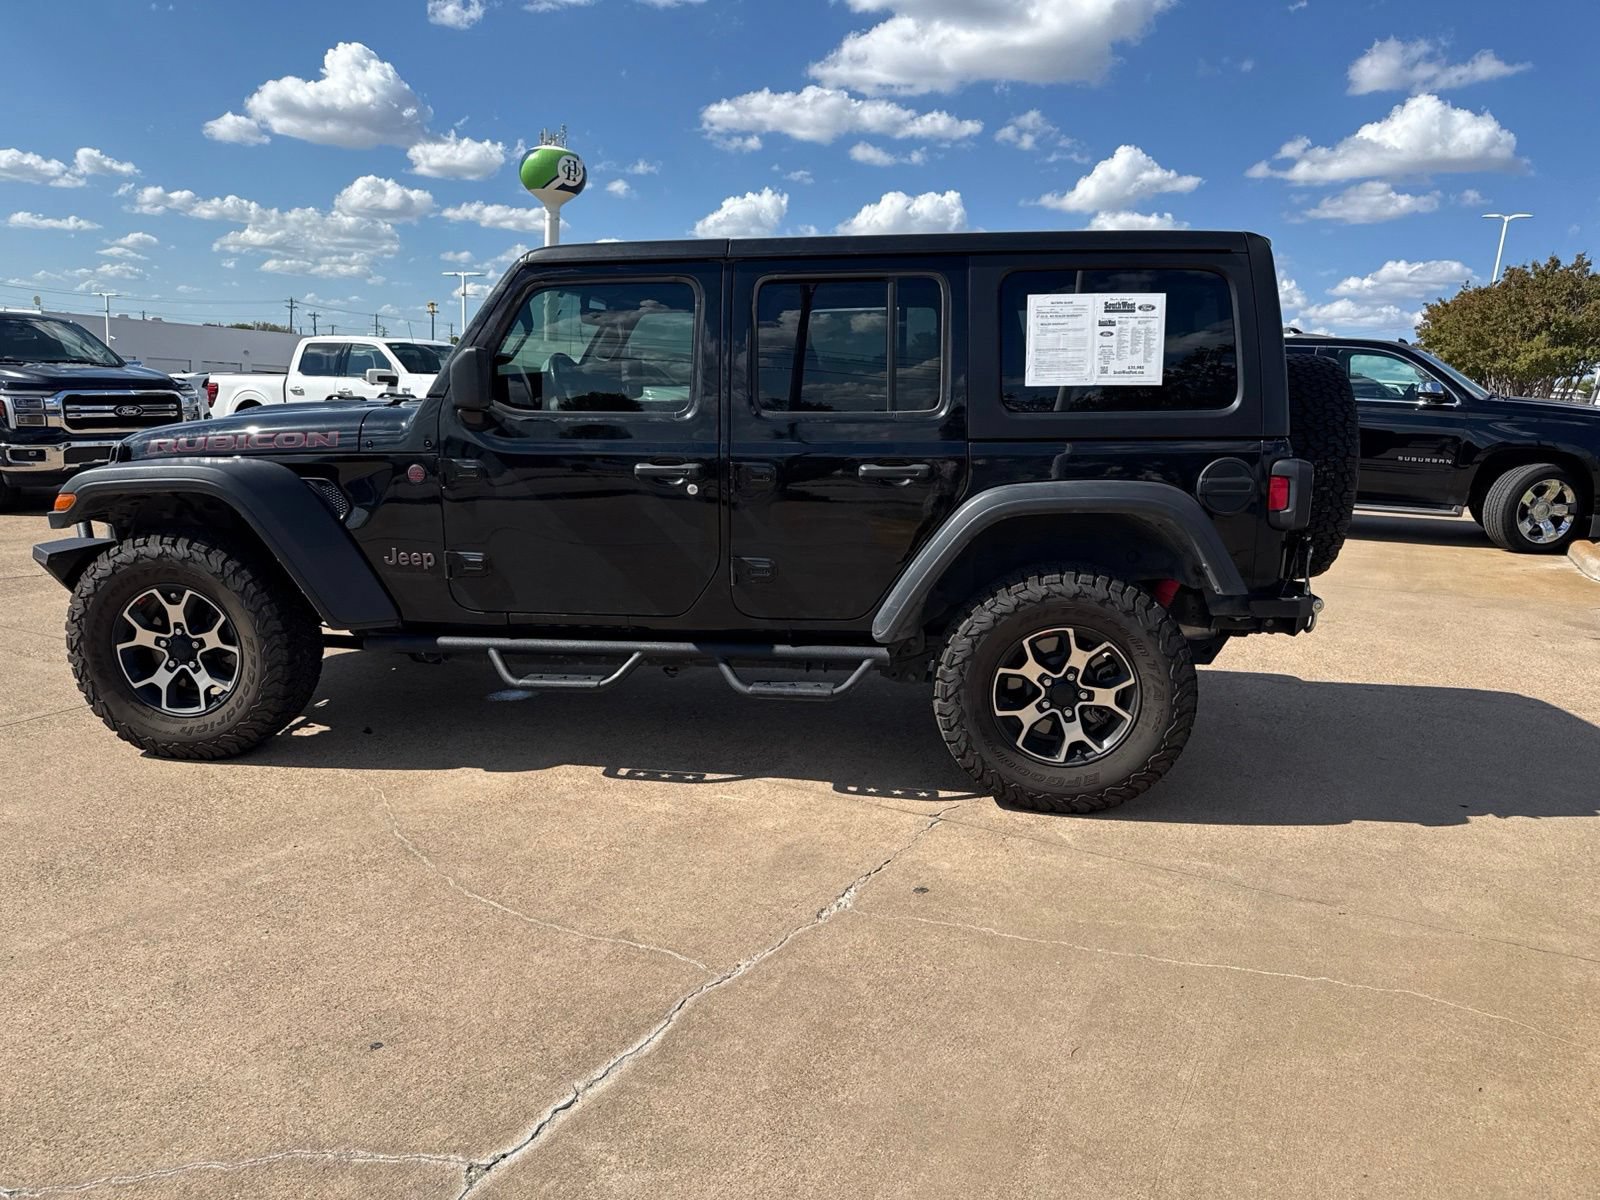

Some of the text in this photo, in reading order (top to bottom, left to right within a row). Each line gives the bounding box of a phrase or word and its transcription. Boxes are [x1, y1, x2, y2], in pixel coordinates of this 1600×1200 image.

[146, 431, 339, 455] RUBICON
[1397, 455, 1453, 465] SUBURBAN
[384, 547, 436, 569] Jeep
